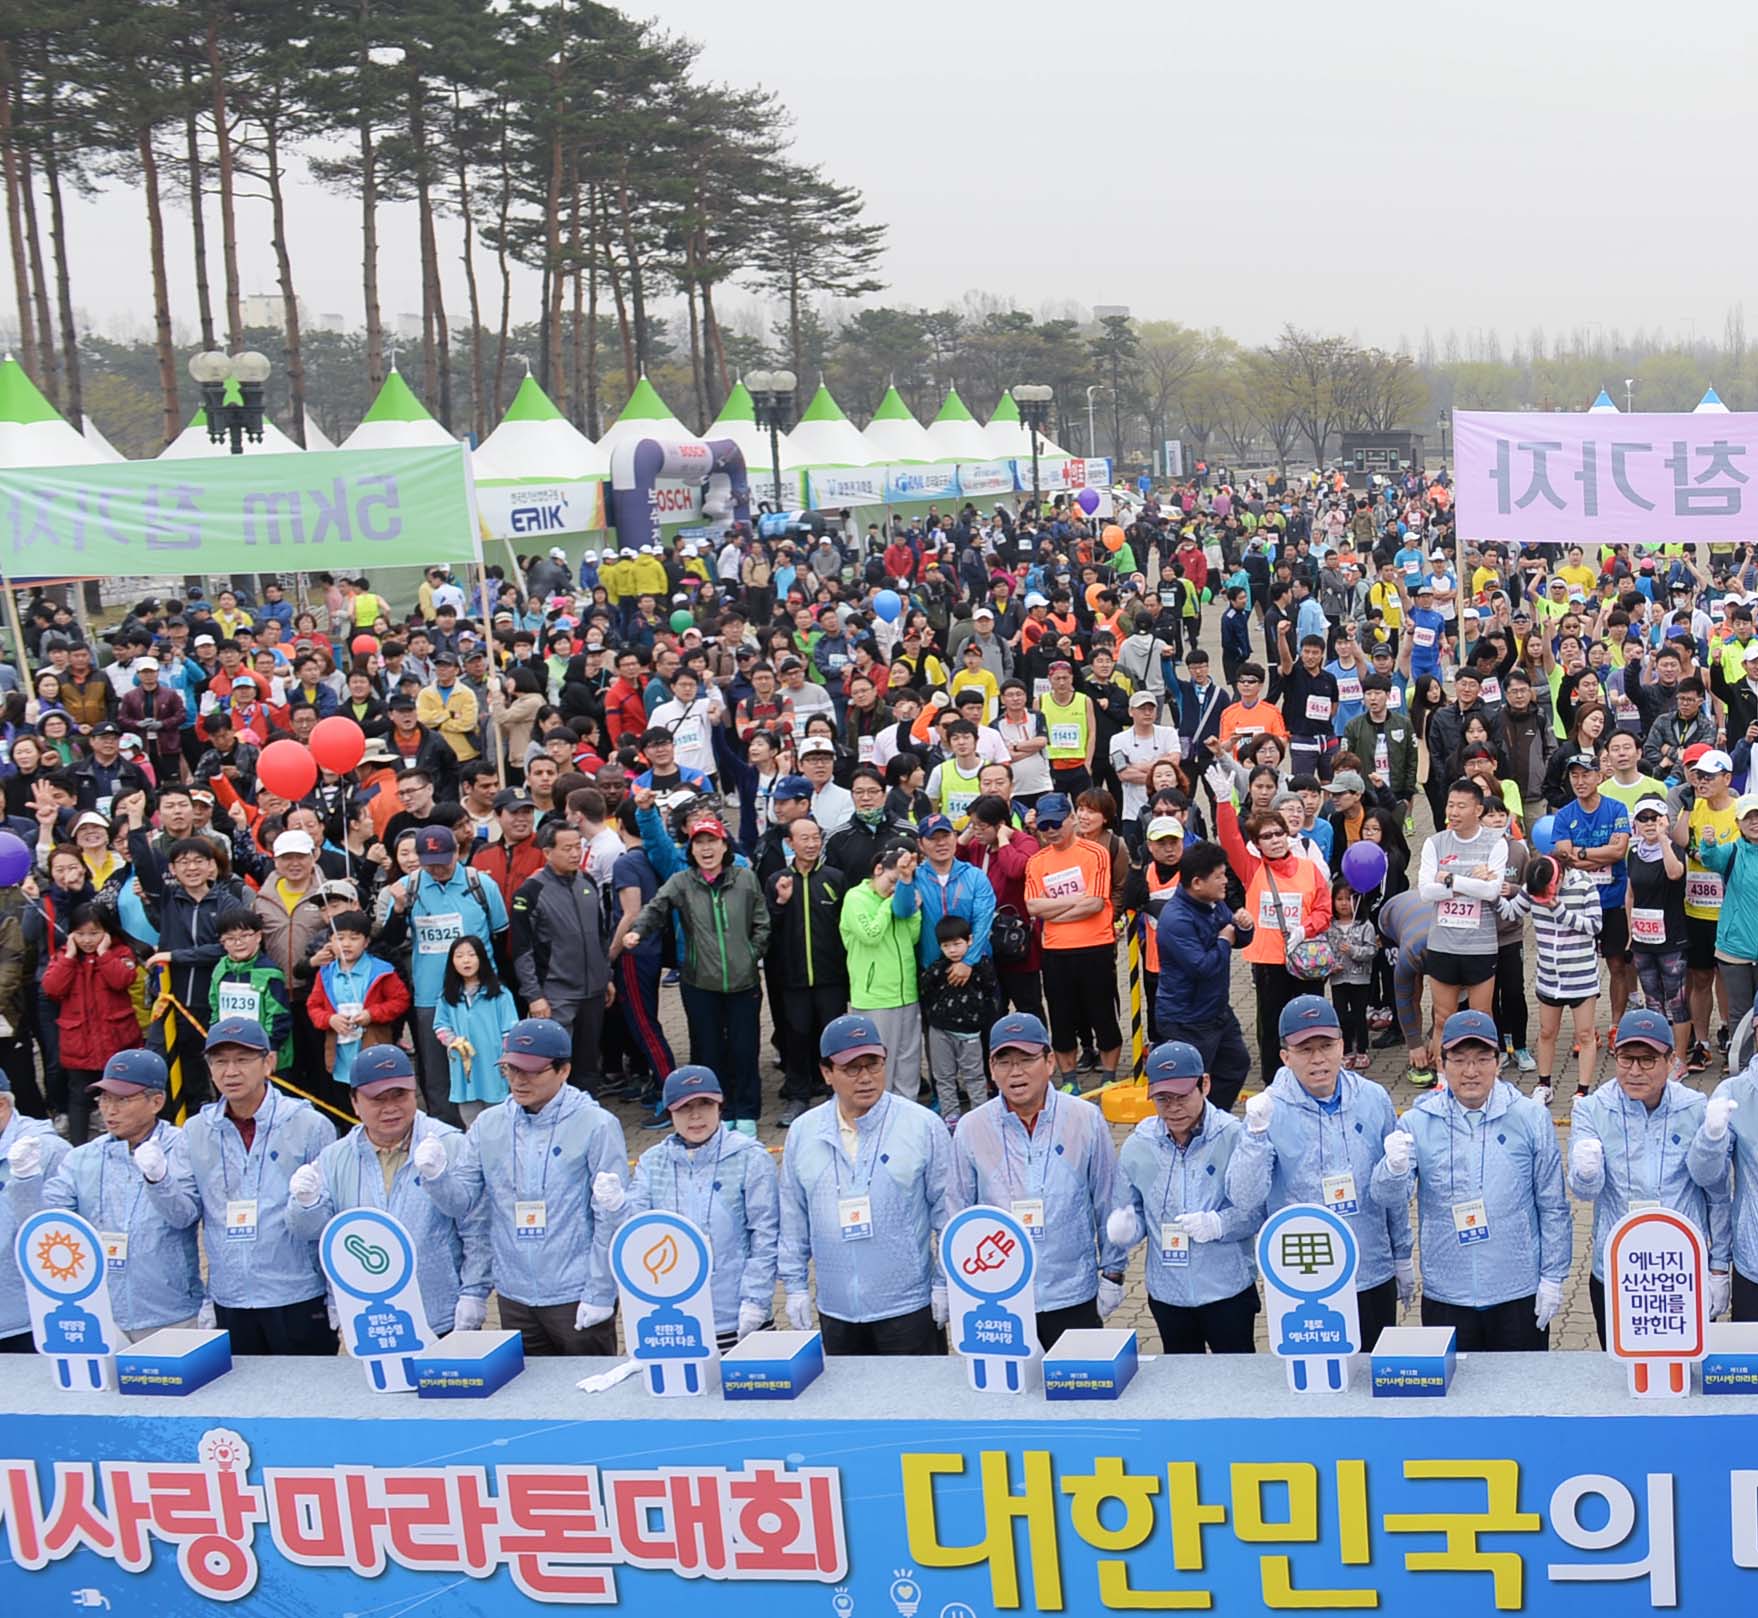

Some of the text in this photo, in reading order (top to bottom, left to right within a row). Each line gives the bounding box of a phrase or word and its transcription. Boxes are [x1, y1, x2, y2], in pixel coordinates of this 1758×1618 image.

[655, 487, 693, 512] OSCH
[511, 505, 565, 532] ERIK
[1048, 880, 1079, 898] 3479
[1689, 883, 1717, 896] 4386
[1262, 905, 1299, 917] 1502
[1442, 902, 1473, 915] 3237
[420, 927, 461, 941] 16325
[221, 995, 256, 1010] 11239
[1628, 1251, 1684, 1271] 에너지
[1621, 1272, 1693, 1293] 신산업이
[1631, 1293, 1686, 1314] 미래를
[654, 1323, 685, 1336] 친환경
[974, 1319, 1013, 1332] 수요자원
[1303, 1318, 1325, 1329] 제로
[1631, 1315, 1687, 1336] 밝힌다
[643, 1336, 696, 1348] 에너지 타운
[974, 1331, 1013, 1345] 거래시장
[1288, 1330, 1341, 1343] 에너지 빌딩
[272, 1468, 840, 1595] 마라톤대회
[900, 1449, 1677, 1611] 대한민국의
